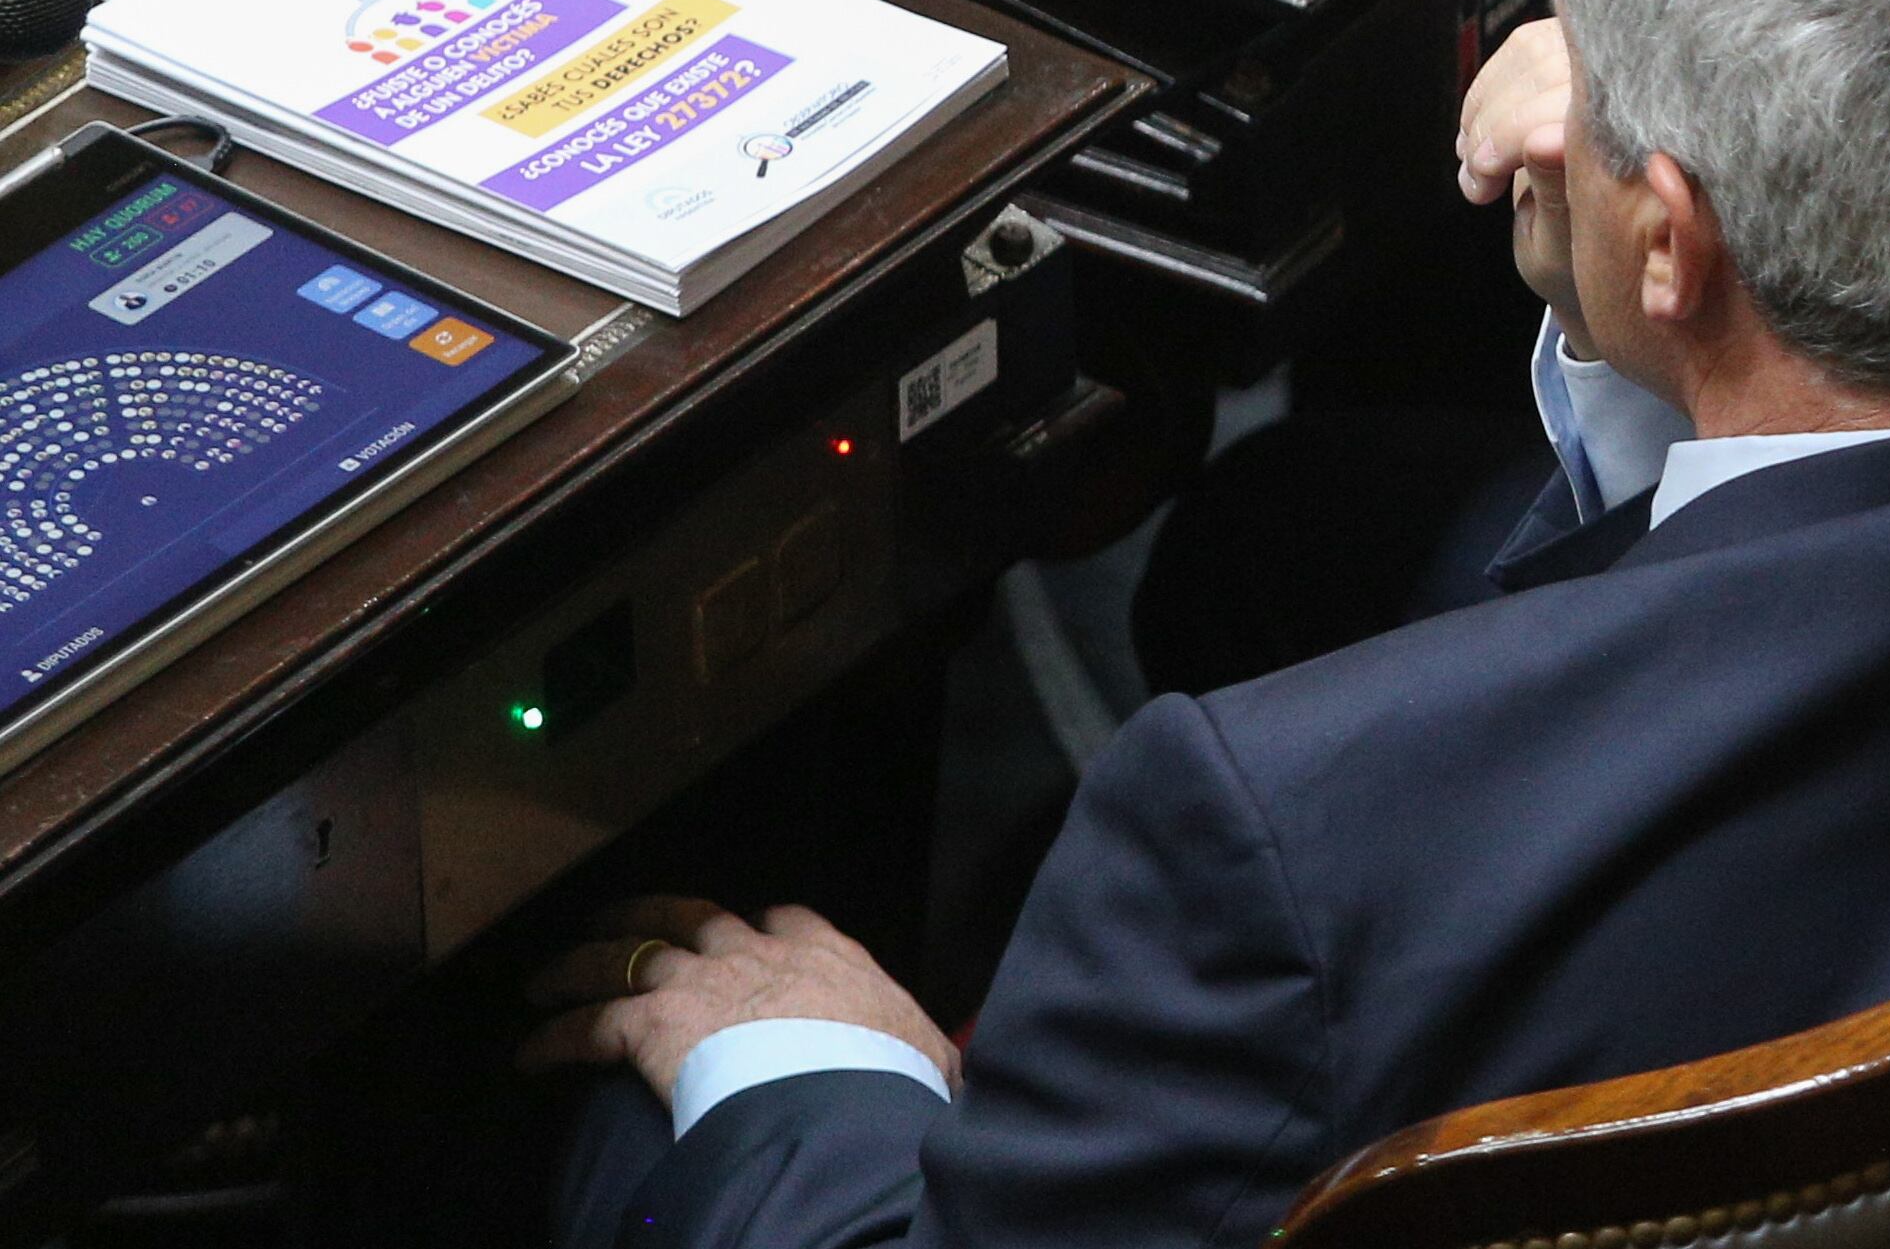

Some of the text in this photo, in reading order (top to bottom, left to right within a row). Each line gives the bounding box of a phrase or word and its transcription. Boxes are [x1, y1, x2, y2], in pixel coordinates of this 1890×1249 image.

[352, 0, 543, 110] ¿FUISTE O CONOCÉS
[551, 18, 700, 112] TUS DERECHOS?
[563, 38, 636, 81] CUÁLES
[632, 7, 682, 38] SON
[373, 106, 396, 120] A
[391, 60, 477, 110] ALGUIEN
[395, 48, 535, 130] DE UN DELITO?
[520, 51, 730, 180] ¿CONOCÉS QUE EXISTE
[579, 149, 624, 175] LA
[613, 125, 662, 157] LEY
[655, 59, 762, 132] 27372?
[69, 182, 178, 251] HAY QUORUM
[354, 421, 416, 460] VOTACIÓN
[36, 626, 104, 671] DIPUTADOS
